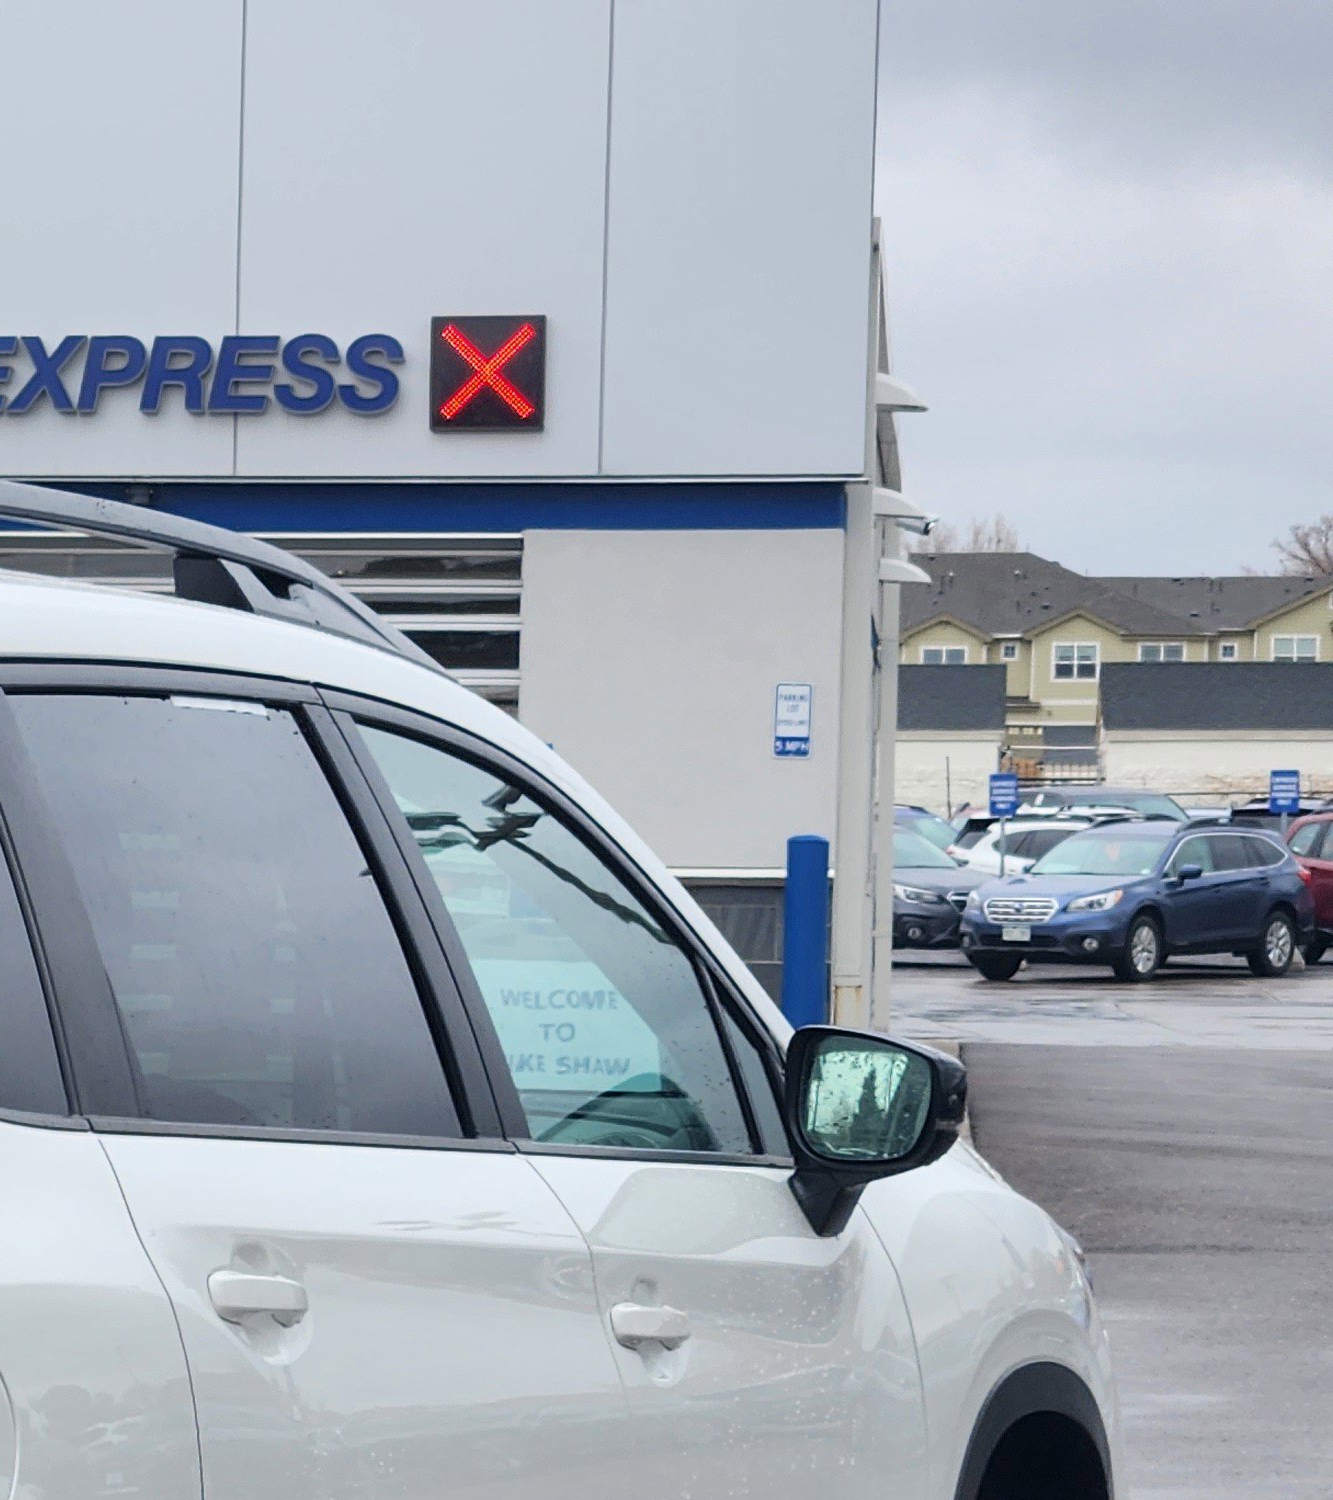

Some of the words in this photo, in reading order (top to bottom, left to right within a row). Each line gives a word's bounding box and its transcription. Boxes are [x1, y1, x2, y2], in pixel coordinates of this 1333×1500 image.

[500, 988, 619, 1010] WELCOME
[539, 1022, 576, 1042] TO
[555, 1055, 630, 1075] SHAW
